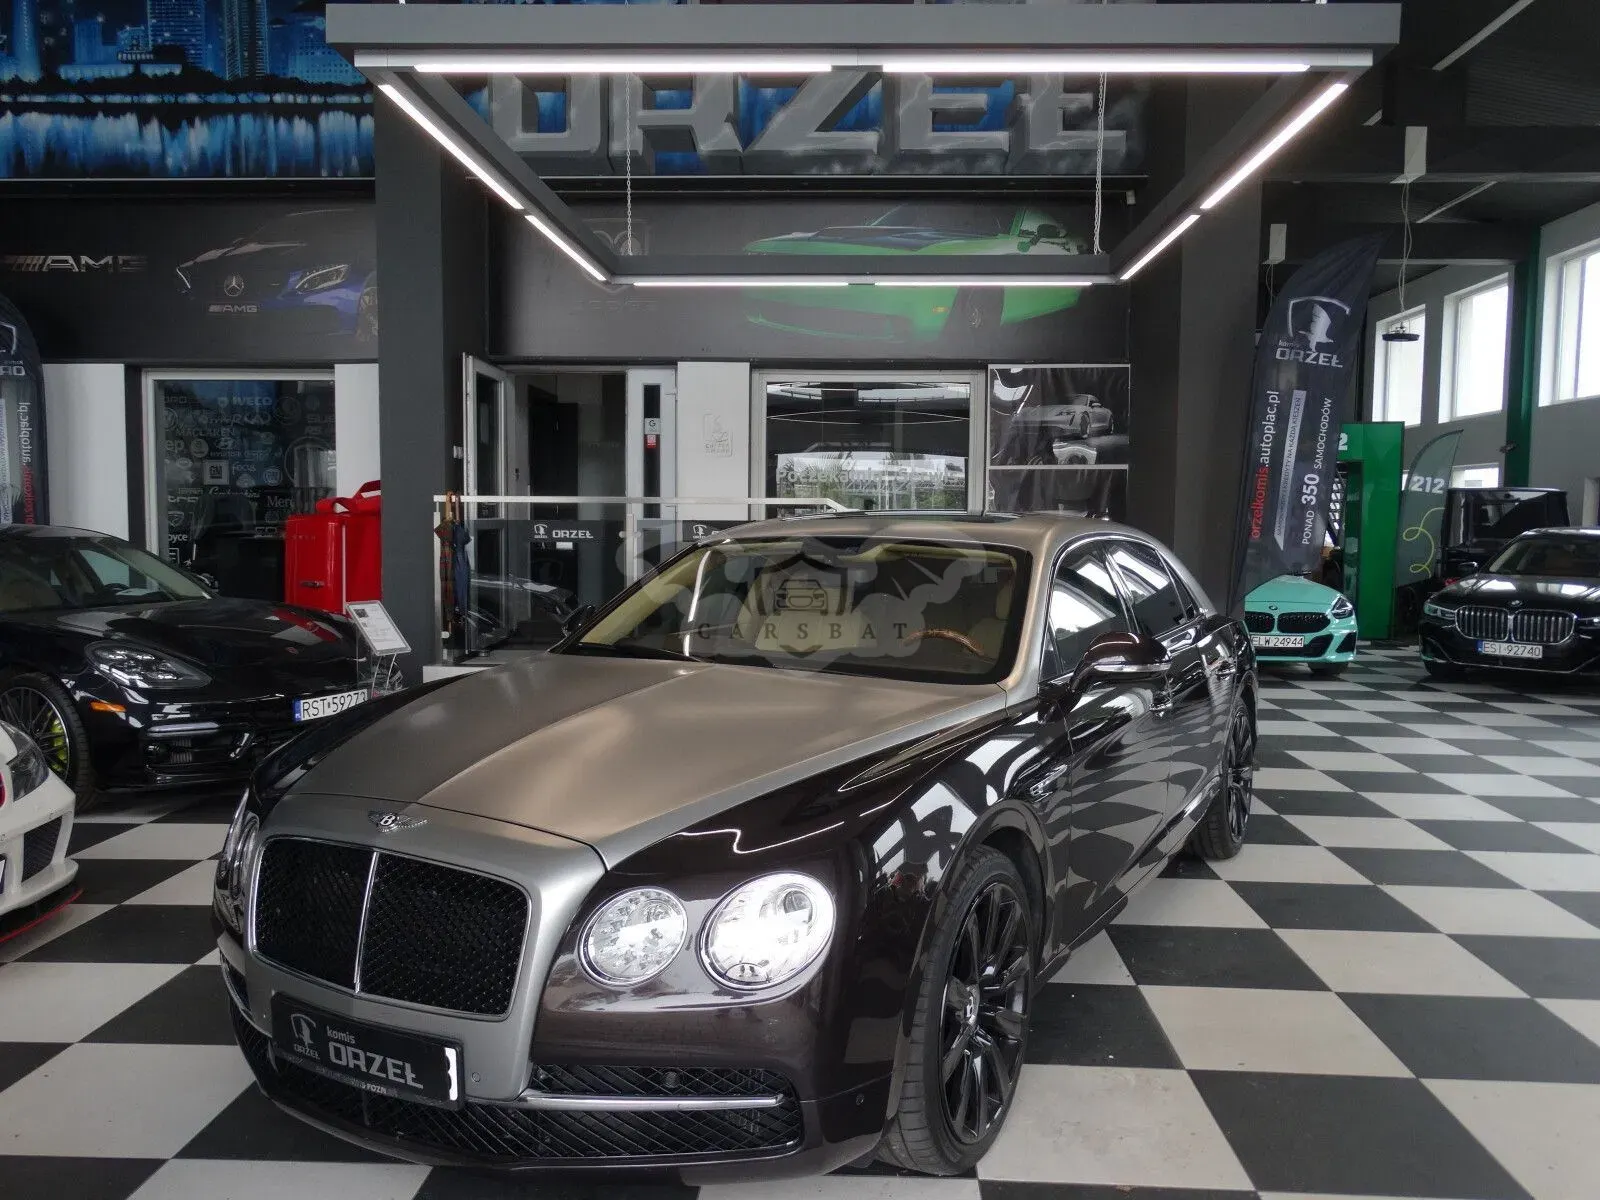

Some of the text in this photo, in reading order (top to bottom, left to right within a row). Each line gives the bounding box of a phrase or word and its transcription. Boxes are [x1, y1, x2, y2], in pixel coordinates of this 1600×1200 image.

[490, 72, 1126, 170] ORZEŁ
[222, 304, 258, 313] AMG
[1275, 347, 1344, 368] ORZEŁ
[1250, 390, 1280, 539] orzelkomis.autoplac.pl
[1301, 397, 1332, 545] PONAD 350 SAMOCHODÓW
[1410, 475, 1445, 494] 212
[552, 530, 594, 539] ORZEŁ
[1274, 637, 1303, 647] 24944
[1506, 645, 1541, 657] 92740
[302, 697, 327, 718] RST
[326, 1026, 355, 1044] komis
[328, 1041, 423, 1089] ORZEŁ
